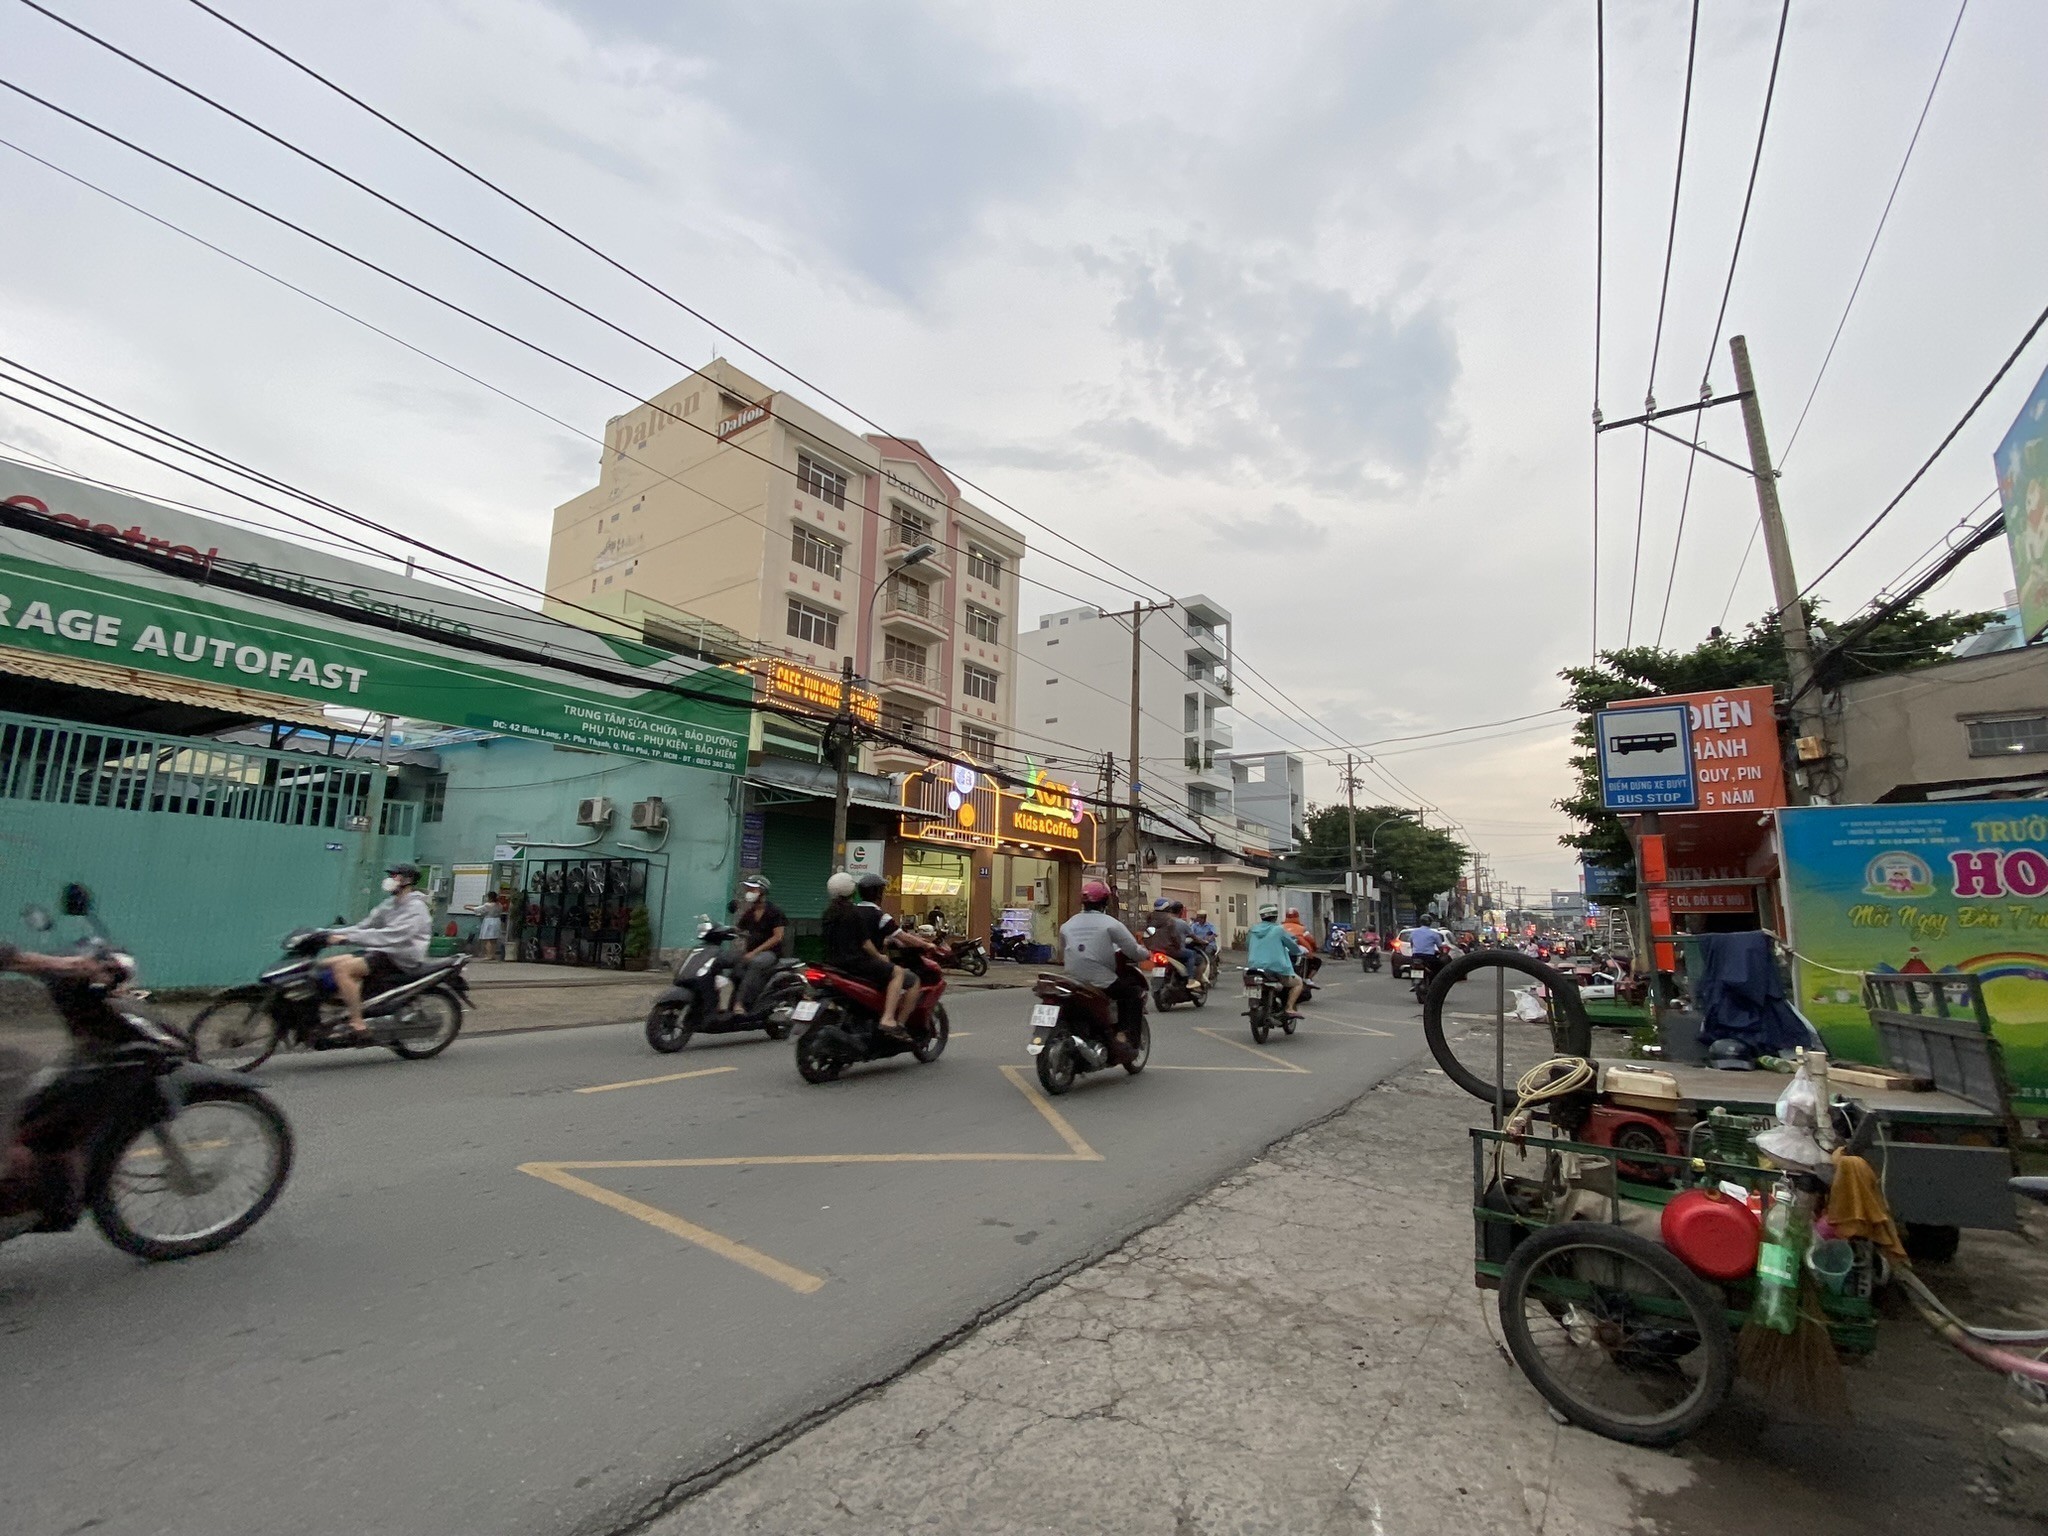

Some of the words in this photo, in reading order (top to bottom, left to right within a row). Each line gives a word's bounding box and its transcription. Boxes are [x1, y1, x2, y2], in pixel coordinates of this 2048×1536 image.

[613, 391, 700, 456] Dalton
[720, 405, 765, 437] Dalton
[132, 624, 368, 694] AUTOFAST
[509, 723, 520, 732] 42
[563, 732, 571, 741] P.
[663, 751, 678, 760] HCM
[564, 704, 601, 720] TRUNG
[604, 711, 625, 725] TÂM
[627, 717, 648, 730] SỬA
[650, 722, 678, 736] CHỮA
[685, 729, 703, 740] BẢO
[705, 734, 738, 748] DƯỠNG
[582, 722, 605, 736] PHỤ
[607, 726, 635, 740] TÙNG
[643, 734, 664, 747] PHỤ
[666, 738, 688, 751] KIỆN
[695, 743, 713, 755] BẢO
[715, 747, 737, 760] HIỂM
[1654, 779, 1664, 789] XE
[1737, 765, 1762, 780] PIN
[1617, 793, 1643, 803] BUS
[1647, 792, 1681, 803] STOP
[1706, 792, 1715, 805] 5
[1722, 786, 1755, 805] NĂM
